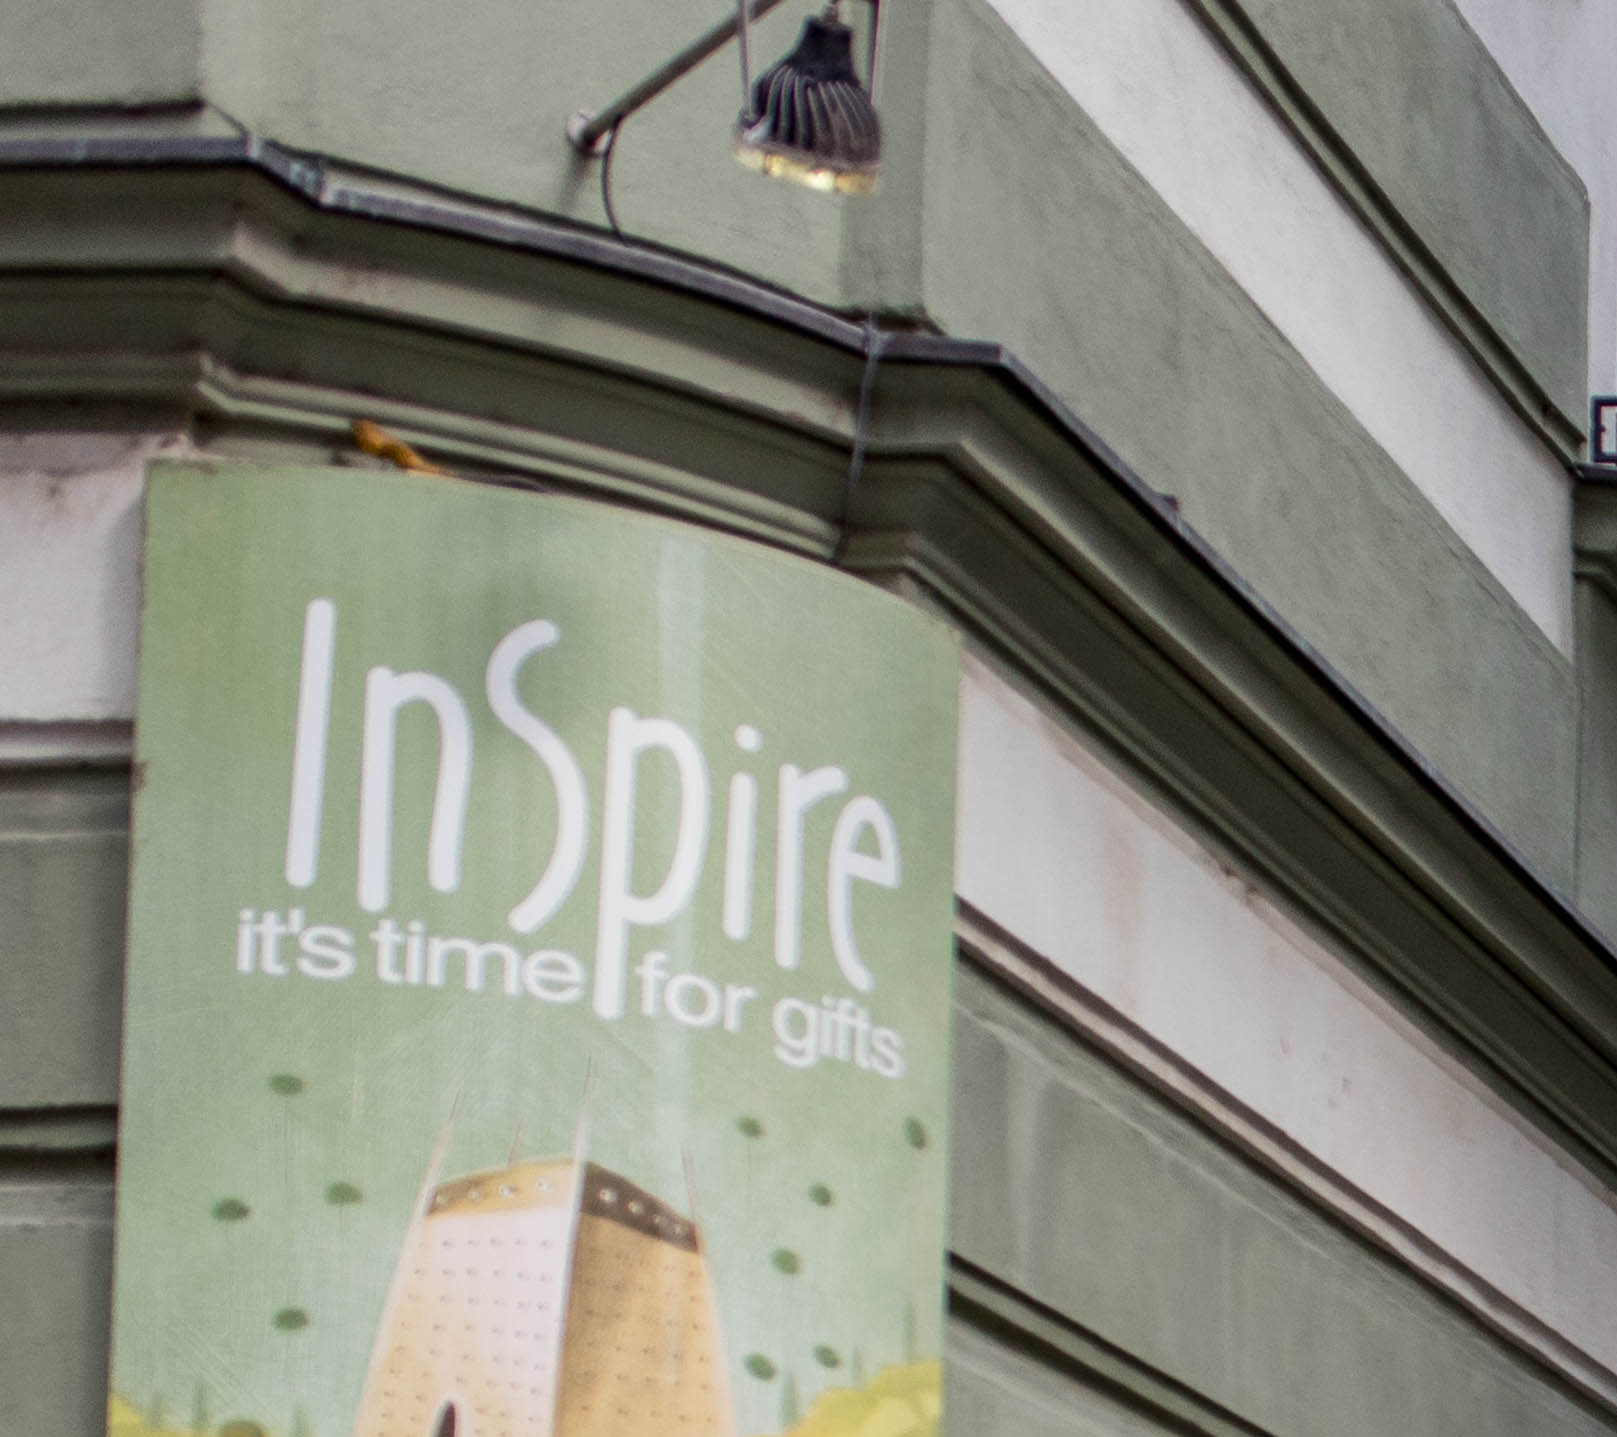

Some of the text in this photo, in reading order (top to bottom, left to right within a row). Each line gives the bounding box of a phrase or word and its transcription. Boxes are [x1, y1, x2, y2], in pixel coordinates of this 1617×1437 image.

[284, 598, 902, 1021] InSpire
[236, 908, 906, 1078] it's time for gifts
